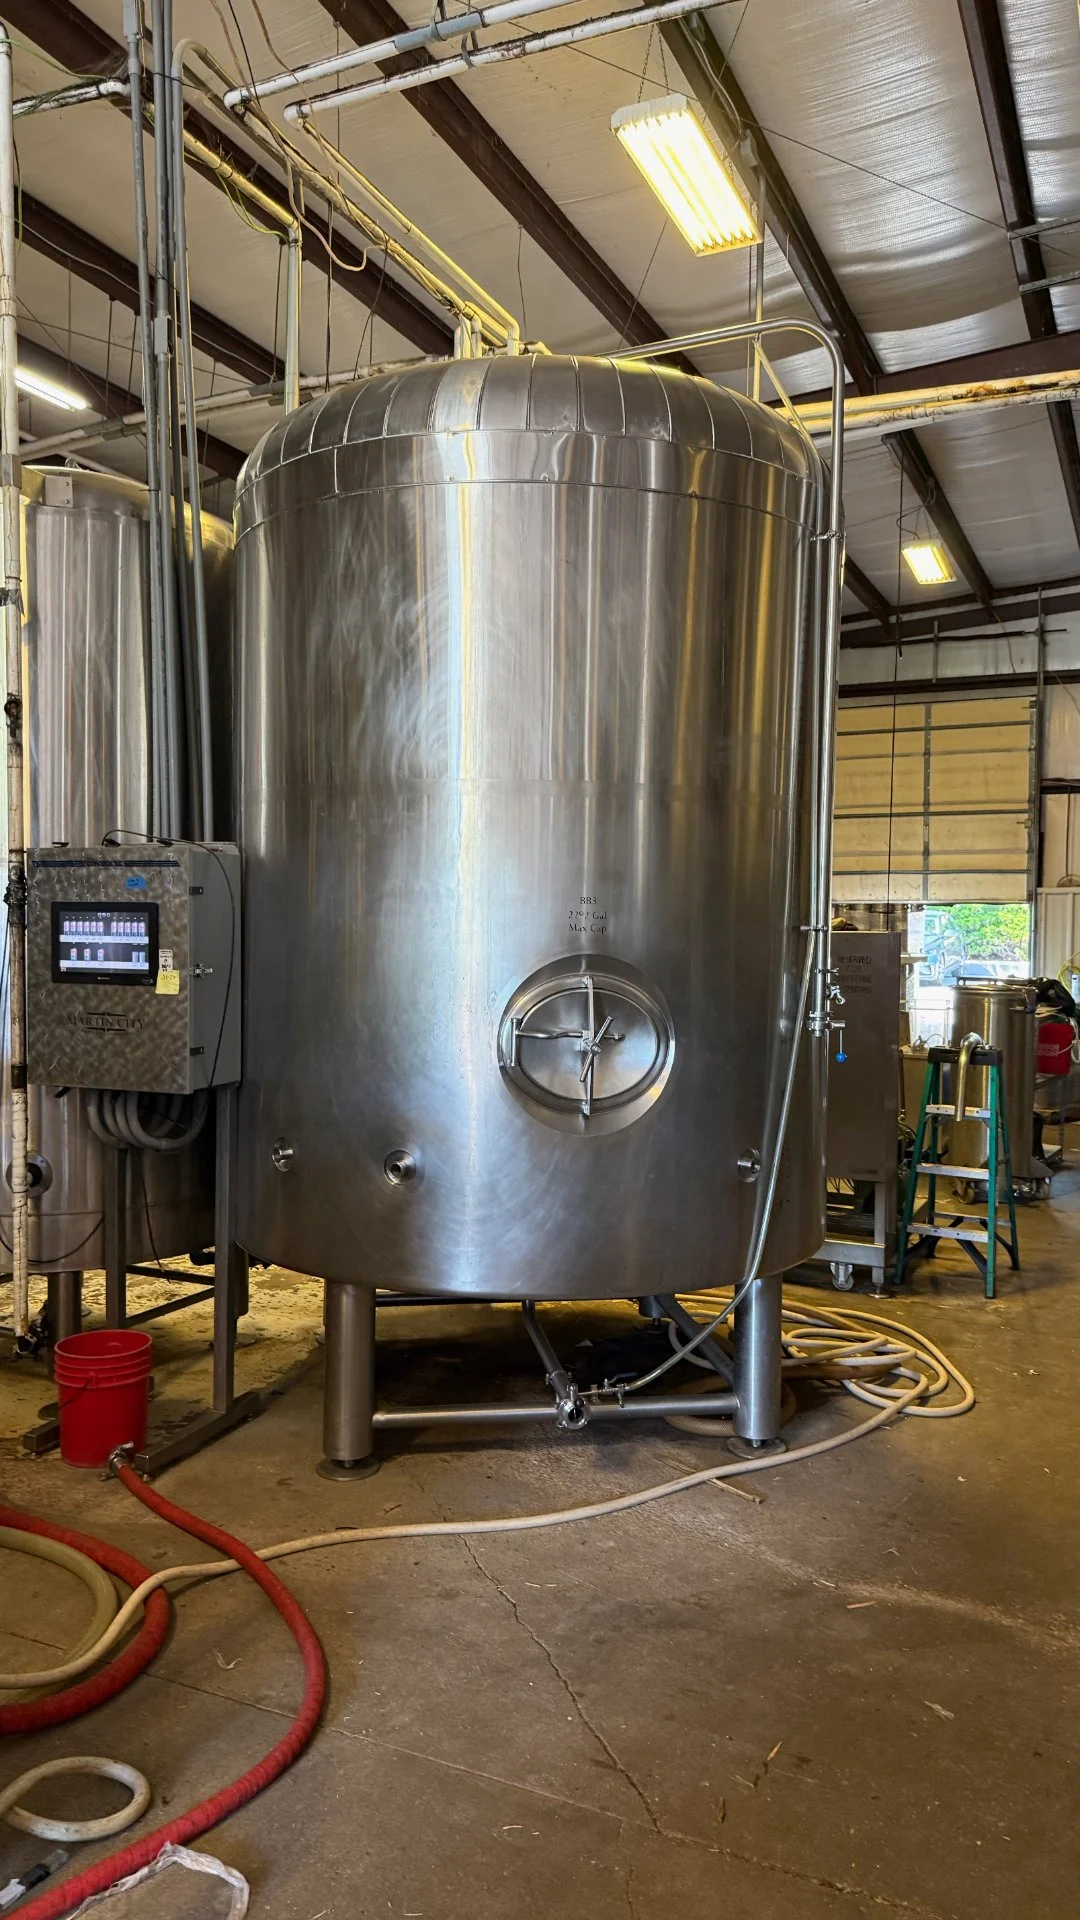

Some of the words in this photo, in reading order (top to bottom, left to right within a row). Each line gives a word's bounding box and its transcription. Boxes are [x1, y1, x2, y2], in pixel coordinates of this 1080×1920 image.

[592, 911, 607, 920] Gal
[568, 923, 588, 932] Max
[590, 923, 607, 935] Cap
[117, 1018, 144, 1029] CITY
